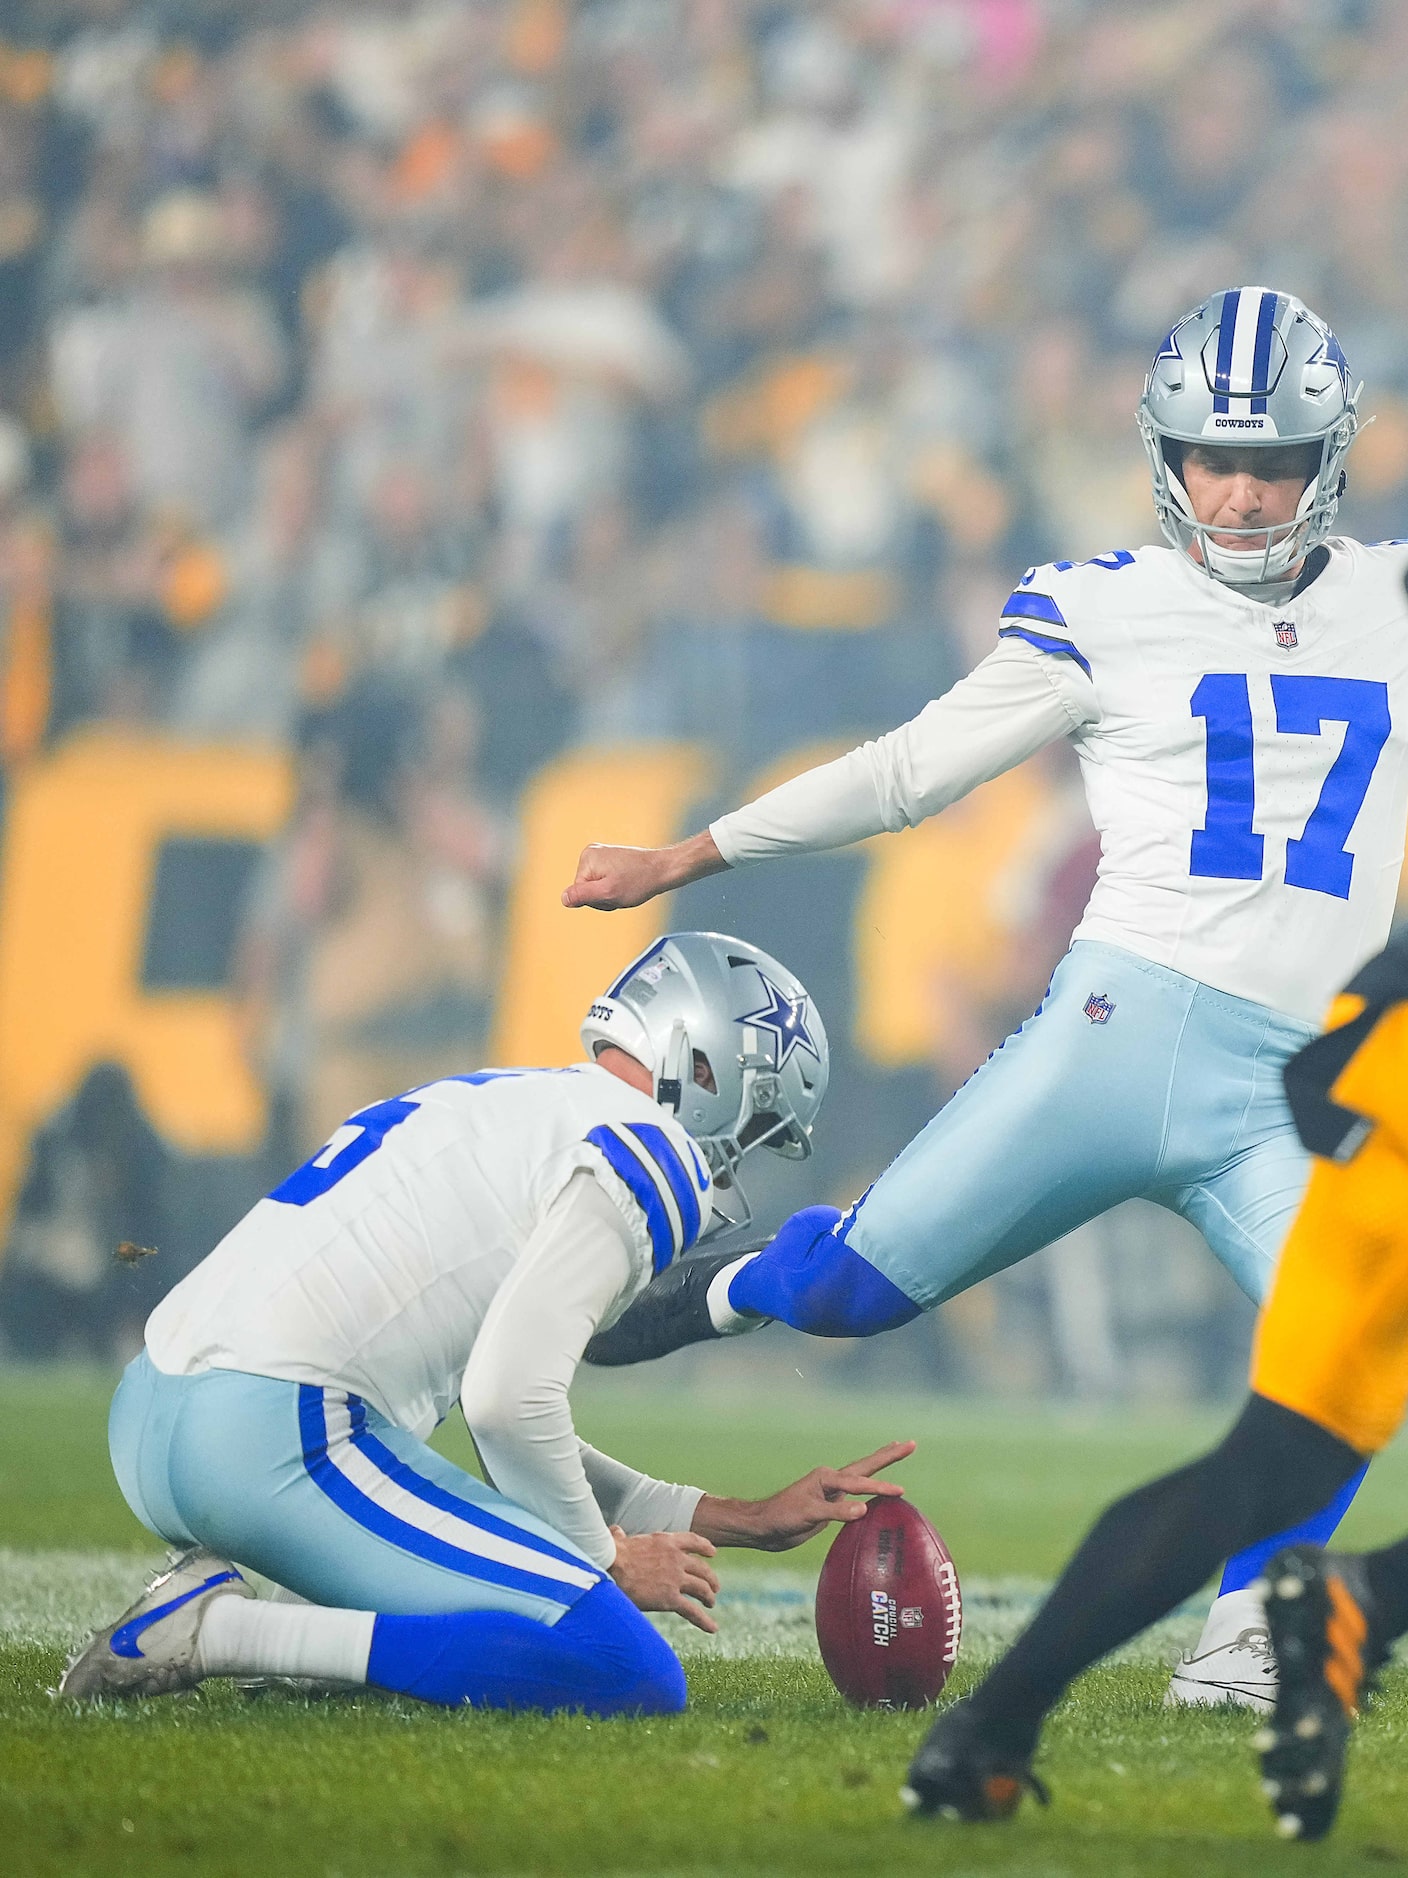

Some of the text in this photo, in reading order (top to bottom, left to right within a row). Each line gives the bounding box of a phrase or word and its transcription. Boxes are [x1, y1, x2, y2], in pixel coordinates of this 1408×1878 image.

[1215, 418, 1264, 429] COWBOYS
[1189, 673, 1392, 901] 17
[870, 1589, 890, 1647] CATCH
[888, 1598, 898, 1639] CRUCIAL
